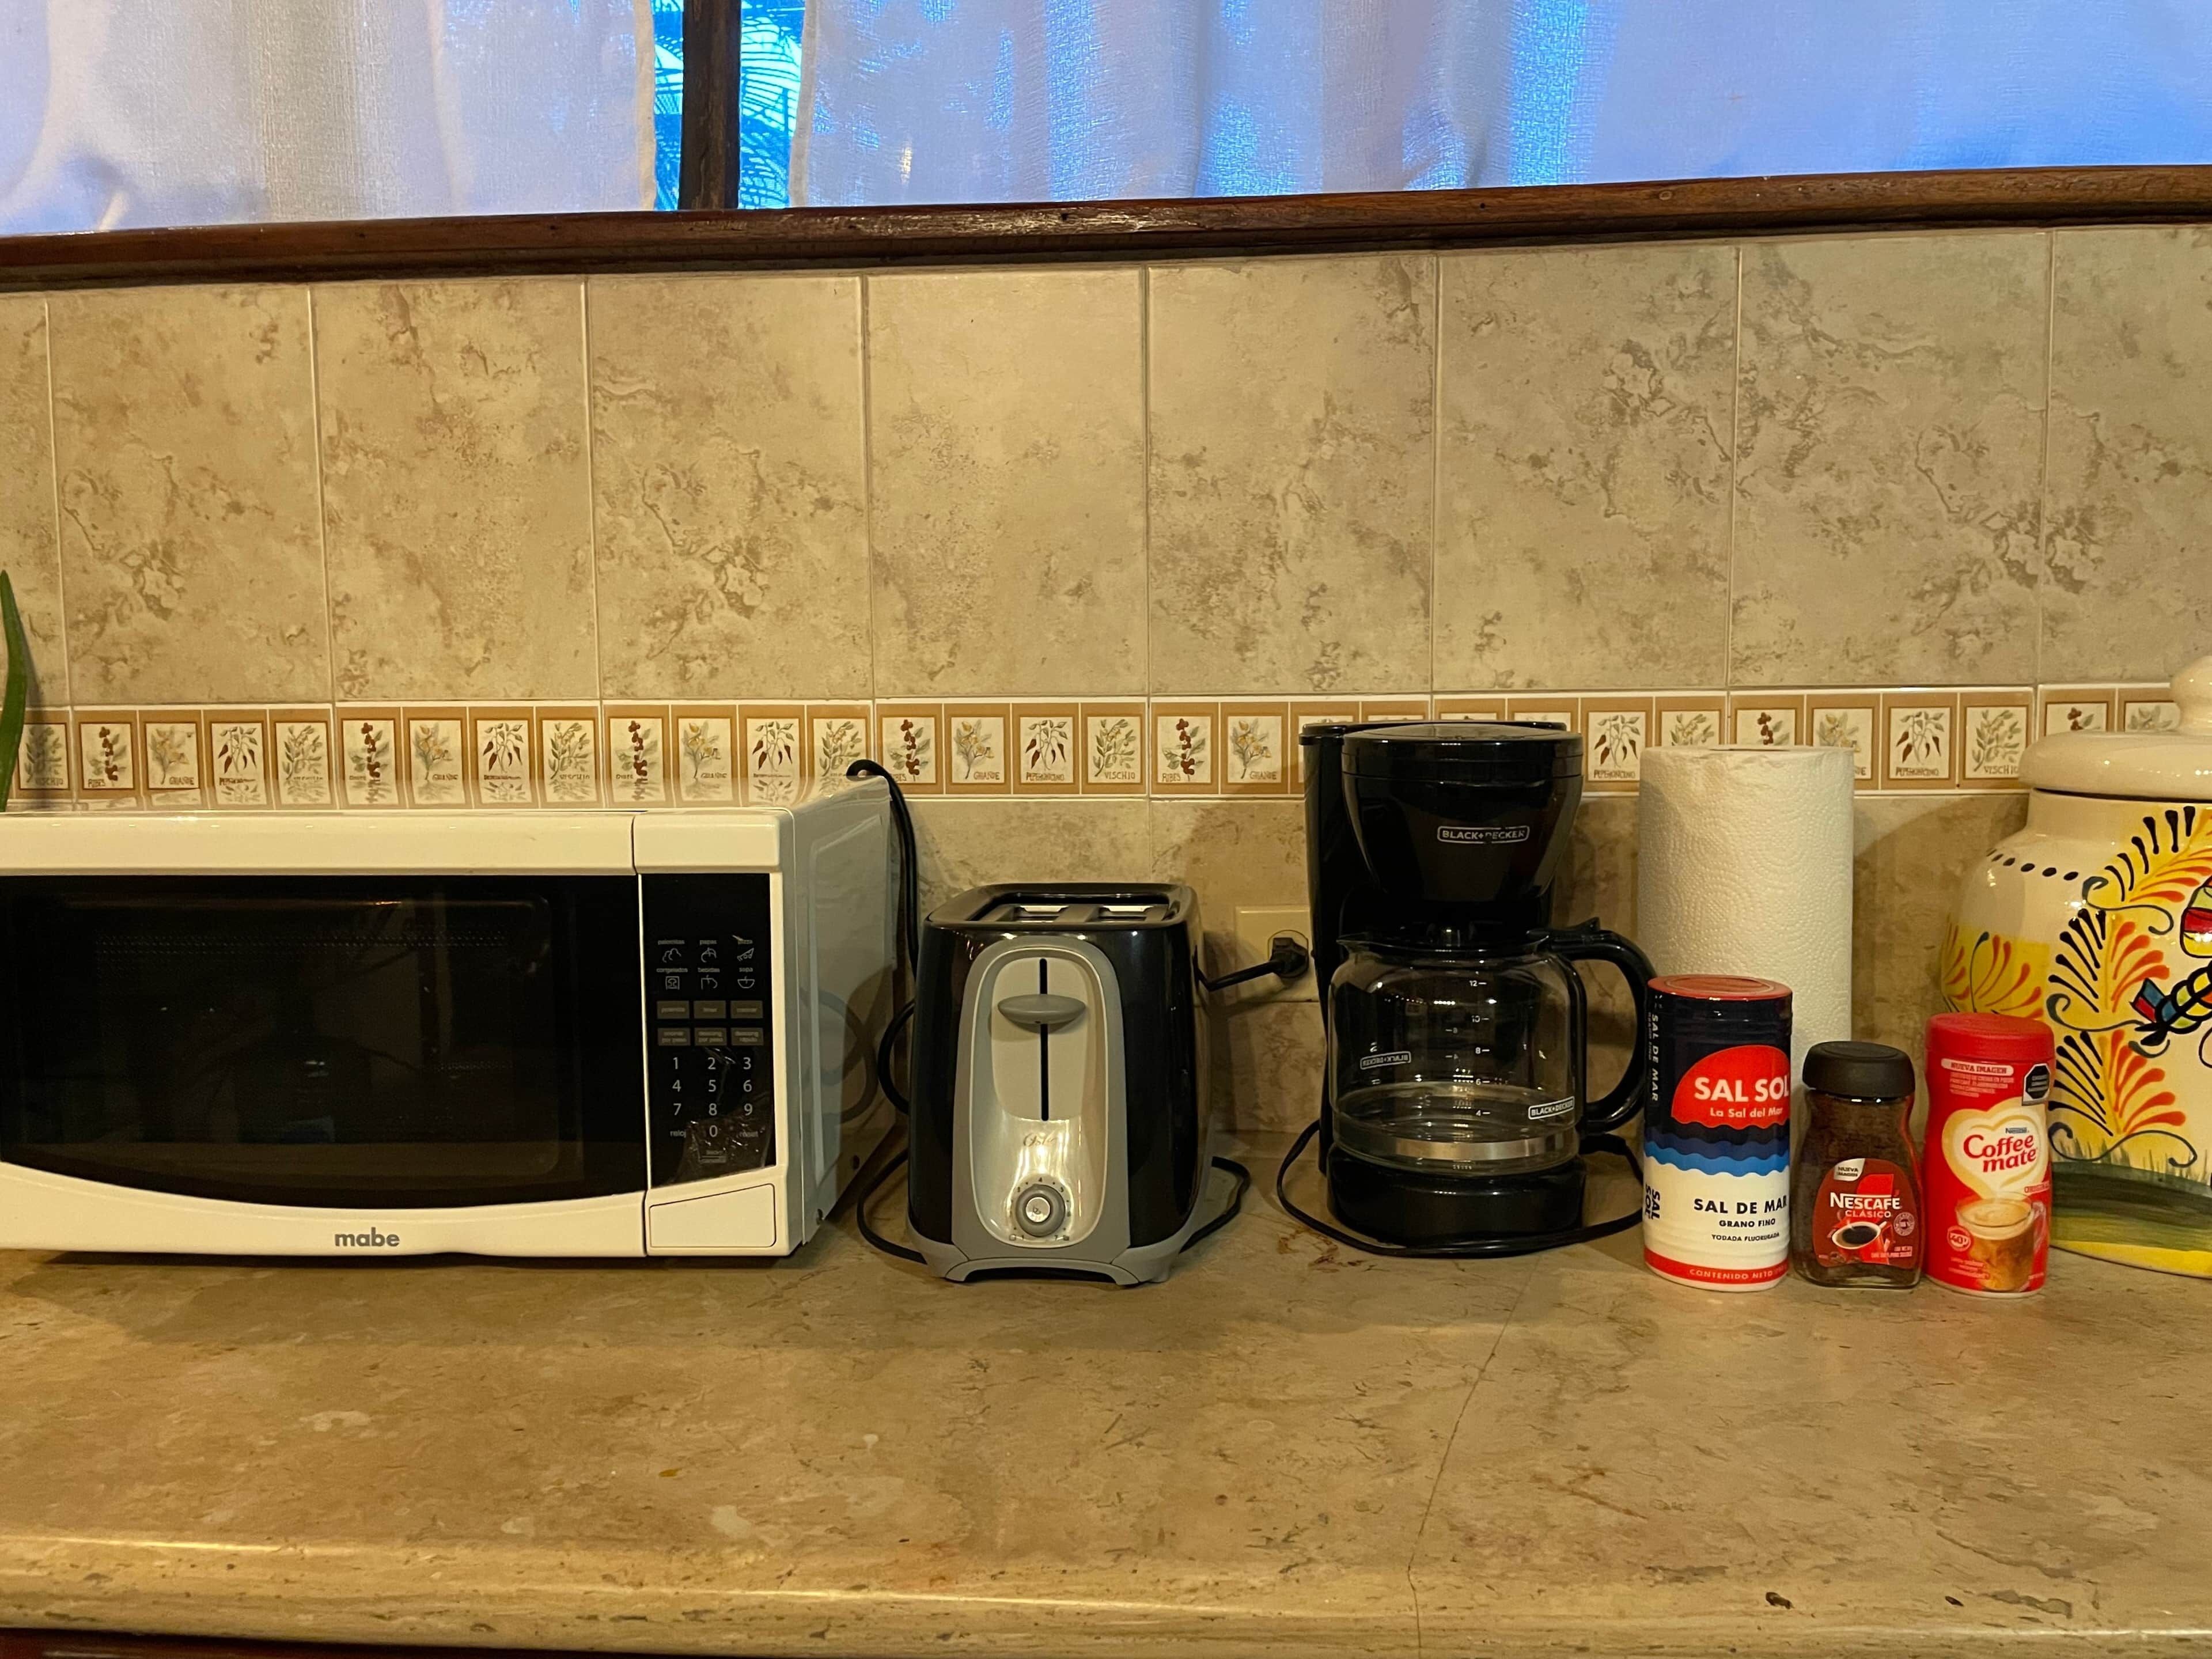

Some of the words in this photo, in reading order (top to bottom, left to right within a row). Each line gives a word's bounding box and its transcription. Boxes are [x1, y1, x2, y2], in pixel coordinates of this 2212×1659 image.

[1104, 771, 1135, 779] VISCHIO
[1162, 773, 1180, 782] RIBES
[1652, 1045, 1659, 1063] DE
[673, 1057, 678, 1070] 1
[707, 1057, 716, 1070] 2
[743, 1057, 751, 1070] 3
[1976, 1066, 2007, 1074] IMAGEN
[672, 1080, 681, 1092] 4
[708, 1080, 716, 1092] 5
[743, 1079, 752, 1092] 6
[1694, 1077, 1749, 1103] SAL
[1755, 1075, 1790, 1103] SOL
[673, 1103, 681, 1116] 7
[709, 1103, 717, 1116] 8
[744, 1103, 753, 1116] 9
[1710, 1107, 1724, 1118] La
[1728, 1107, 1746, 1118] Sal
[1749, 1107, 1766, 1118] del
[1768, 1107, 1783, 1116] Mar
[709, 1125, 718, 1137] 0
[1963, 1134, 2034, 1158] Coffee
[1983, 1149, 2037, 1173] mate
[1651, 1189, 1660, 1219] SAL
[1694, 1198, 1728, 1214] SAL
[1737, 1202, 1757, 1214] DE
[1764, 1195, 1787, 1213] MAR
[1719, 1219, 1755, 1228] GRANO
[1758, 1218, 1776, 1227] FINO
[335, 1227, 400, 1247] mabe
[1689, 1268, 1749, 1280] CONTENIDO
